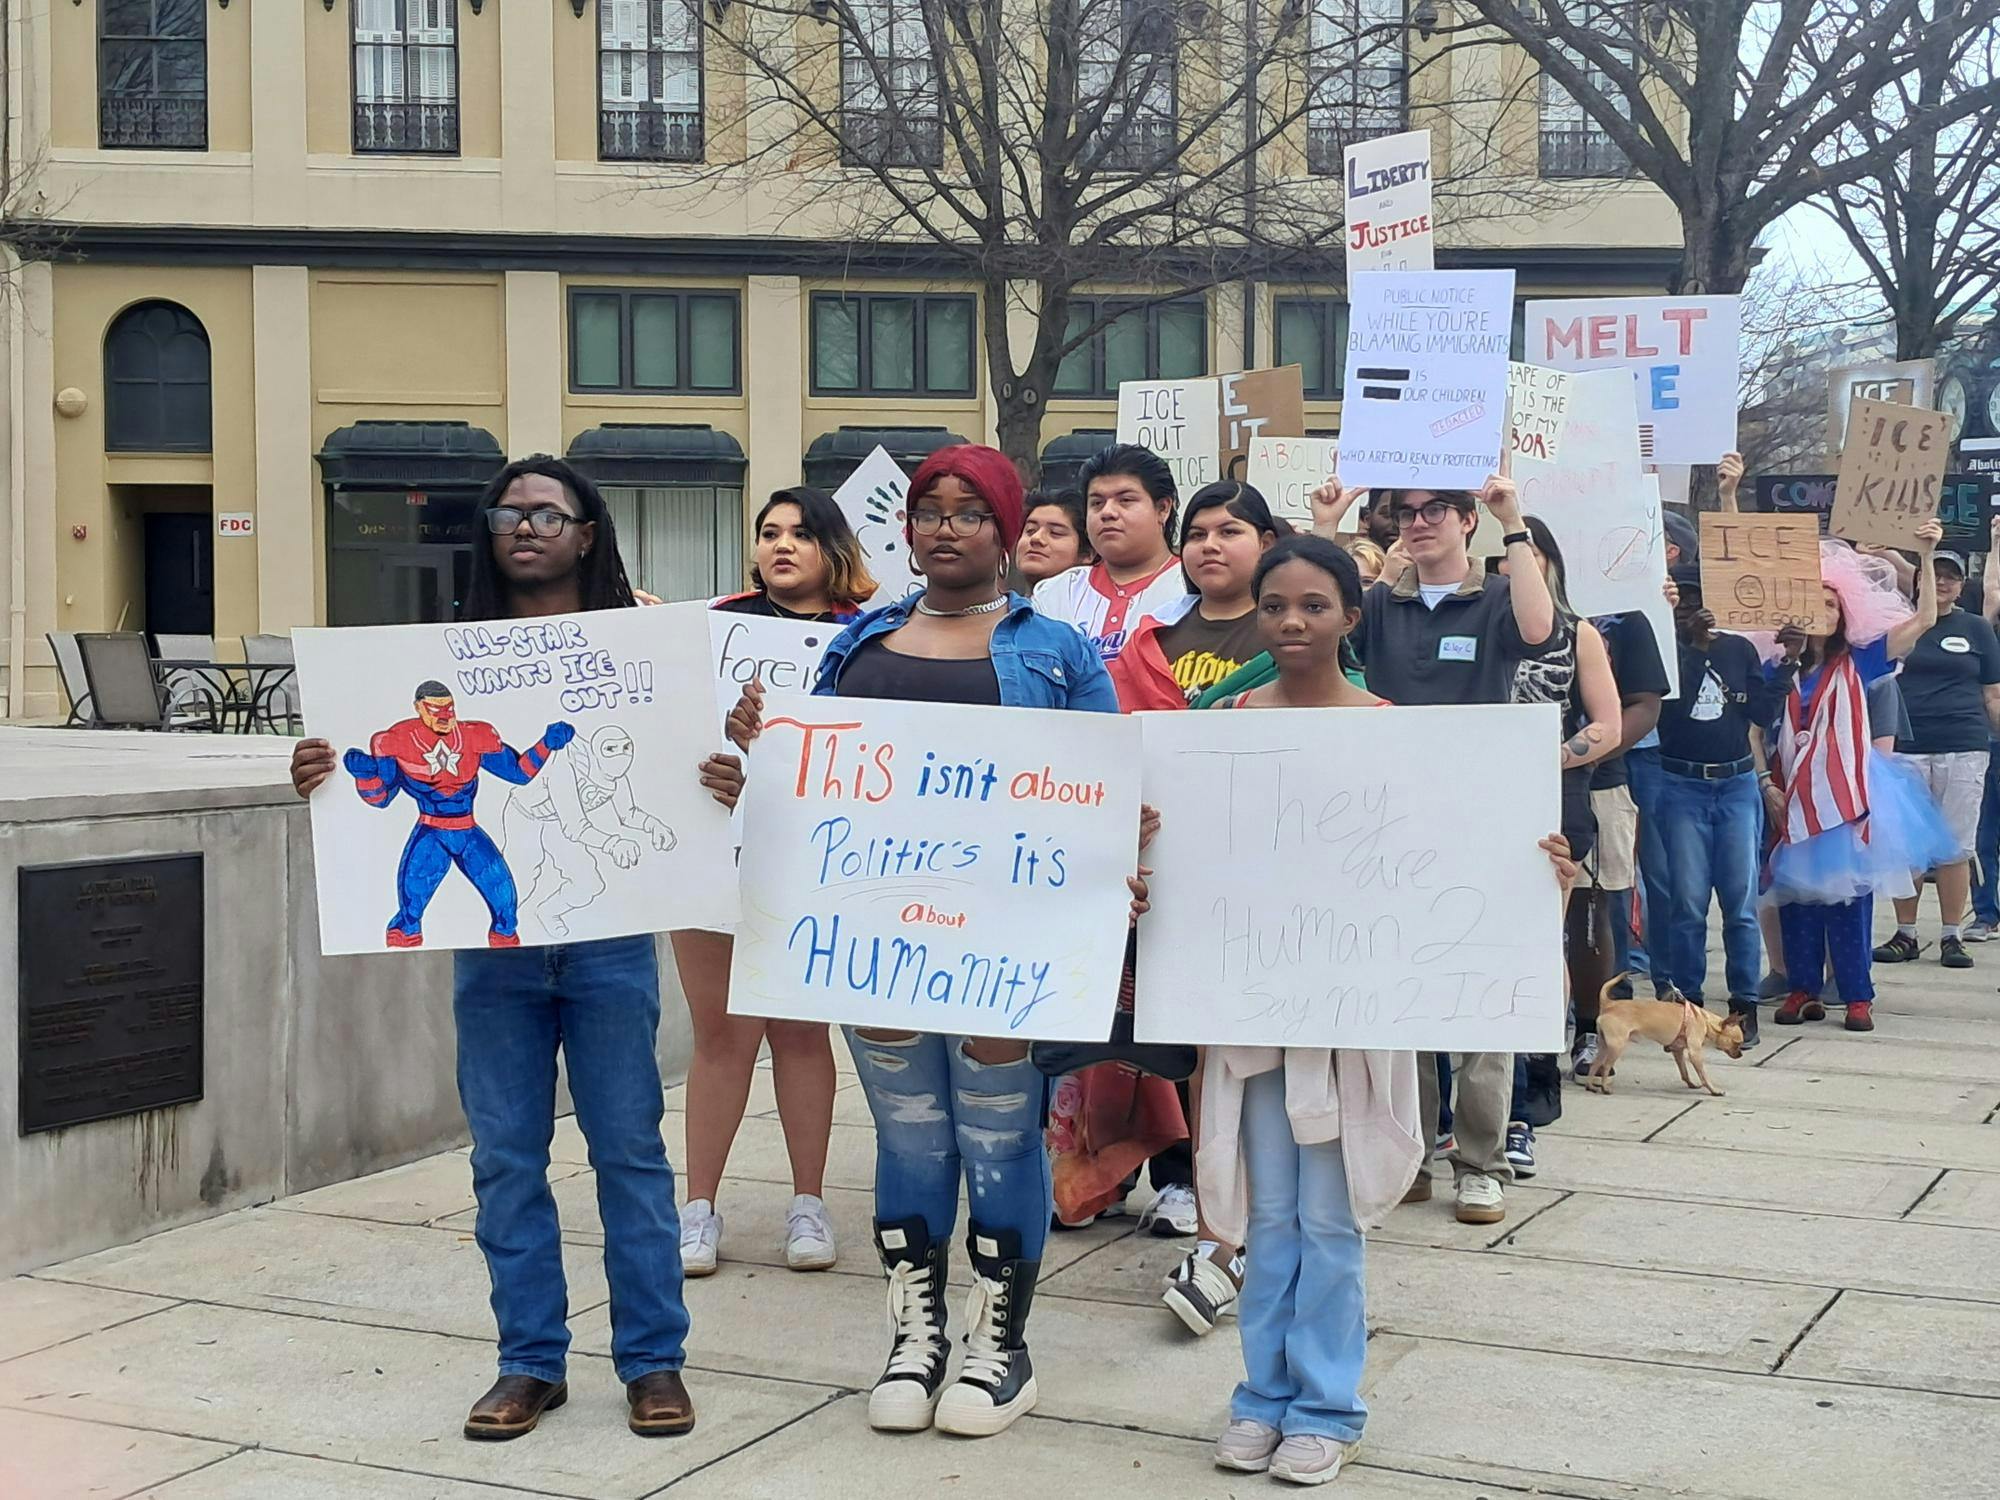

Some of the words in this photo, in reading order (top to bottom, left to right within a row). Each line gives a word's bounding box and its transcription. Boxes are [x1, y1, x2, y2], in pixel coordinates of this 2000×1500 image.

[1348, 157, 1430, 200] LIBERTY
[1350, 214, 1431, 250] JUSTICE
[1383, 288, 1427, 304] PUBLIC
[1431, 287, 1476, 304] NOTICE
[1367, 310, 1418, 332] WHILE
[1425, 310, 1490, 333] YOU'RE
[1544, 309, 1708, 360] MELT
[1349, 331, 1421, 354] BLAMING
[1426, 334, 1509, 354] IMMIGRANTS
[1415, 369, 1428, 382] IS
[1546, 374, 1567, 391] OF
[1137, 388, 1185, 420] ICE
[1404, 387, 1429, 402] OUR
[1431, 388, 1487, 402] CHILDREN
[1522, 390, 1536, 408] IS
[1542, 394, 1567, 414] THE
[1138, 424, 1186, 452] OUT
[1512, 411, 1533, 428] OF
[1535, 416, 1559, 434] MY
[1868, 417, 1932, 451] ICE
[1259, 442, 1336, 474] ABOLIS
[1511, 427, 1546, 459] BOR
[1339, 450, 1366, 461] WHO
[1442, 454, 1499, 469] PROTECTING
[1409, 467, 1421, 480] ?
[1967, 458, 2000, 471] Aboli
[1853, 471, 1938, 515] KILLS
[220, 519, 252, 532] FDC
[1712, 525, 1800, 562] ICE
[1734, 574, 1818, 611] OUT
[1728, 610, 1765, 626] FOR
[444, 621, 588, 660] ALL-STAR
[456, 662, 552, 697] WANTS
[560, 650, 616, 684] ICE
[917, 752, 998, 801] isn't
[1010, 766, 1105, 807] about
[1177, 747, 1409, 874] They
[1356, 848, 1438, 889] are
[900, 903, 967, 929] about
[1411, 885, 1519, 965] 2
[1393, 976, 1430, 1024] 2
[1441, 970, 1549, 1023] ICE
